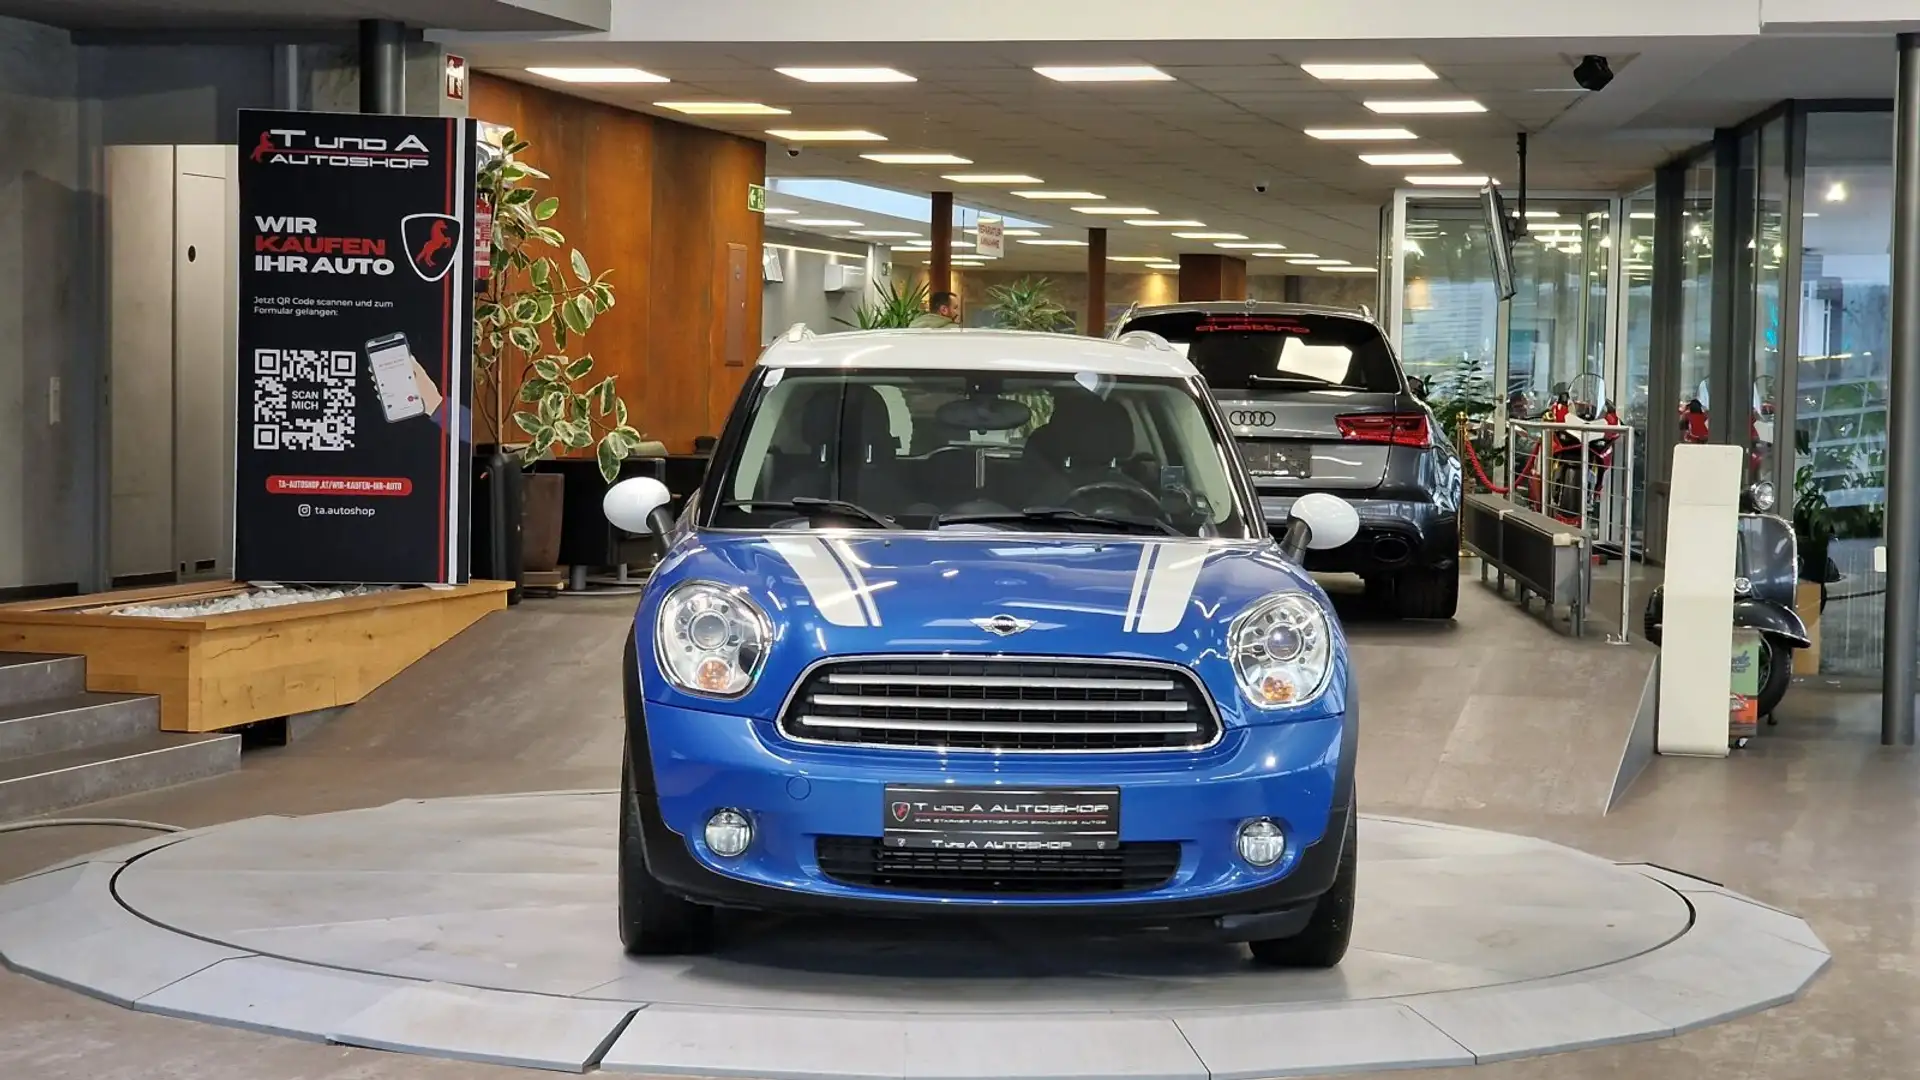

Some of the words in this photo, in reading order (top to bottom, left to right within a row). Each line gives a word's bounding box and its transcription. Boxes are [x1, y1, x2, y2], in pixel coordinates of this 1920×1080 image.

[270, 129, 306, 147] T
[395, 134, 430, 152] A
[270, 154, 430, 169] AUTOSHOP
[255, 215, 317, 234] WIR
[255, 235, 386, 256] KAUFEN
[255, 255, 309, 272] IHR
[311, 258, 395, 276] AUTO
[253, 296, 275, 305] Jetzt
[277, 297, 291, 306] QR
[292, 297, 315, 306] Code
[316, 298, 353, 307] scannen
[355, 300, 372, 308] und
[254, 306, 294, 315] Formular
[295, 307, 339, 318] gelangen:
[1195, 324, 1311, 334] quattro
[291, 391, 319, 400] SCAN
[291, 401, 319, 411] MICH
[314, 506, 376, 517] ta.autoshop
[913, 803, 928, 811] T
[970, 804, 984, 812] A
[990, 804, 1109, 814] AUTOSHOP
[983, 840, 1072, 850] AUTOSHOP
